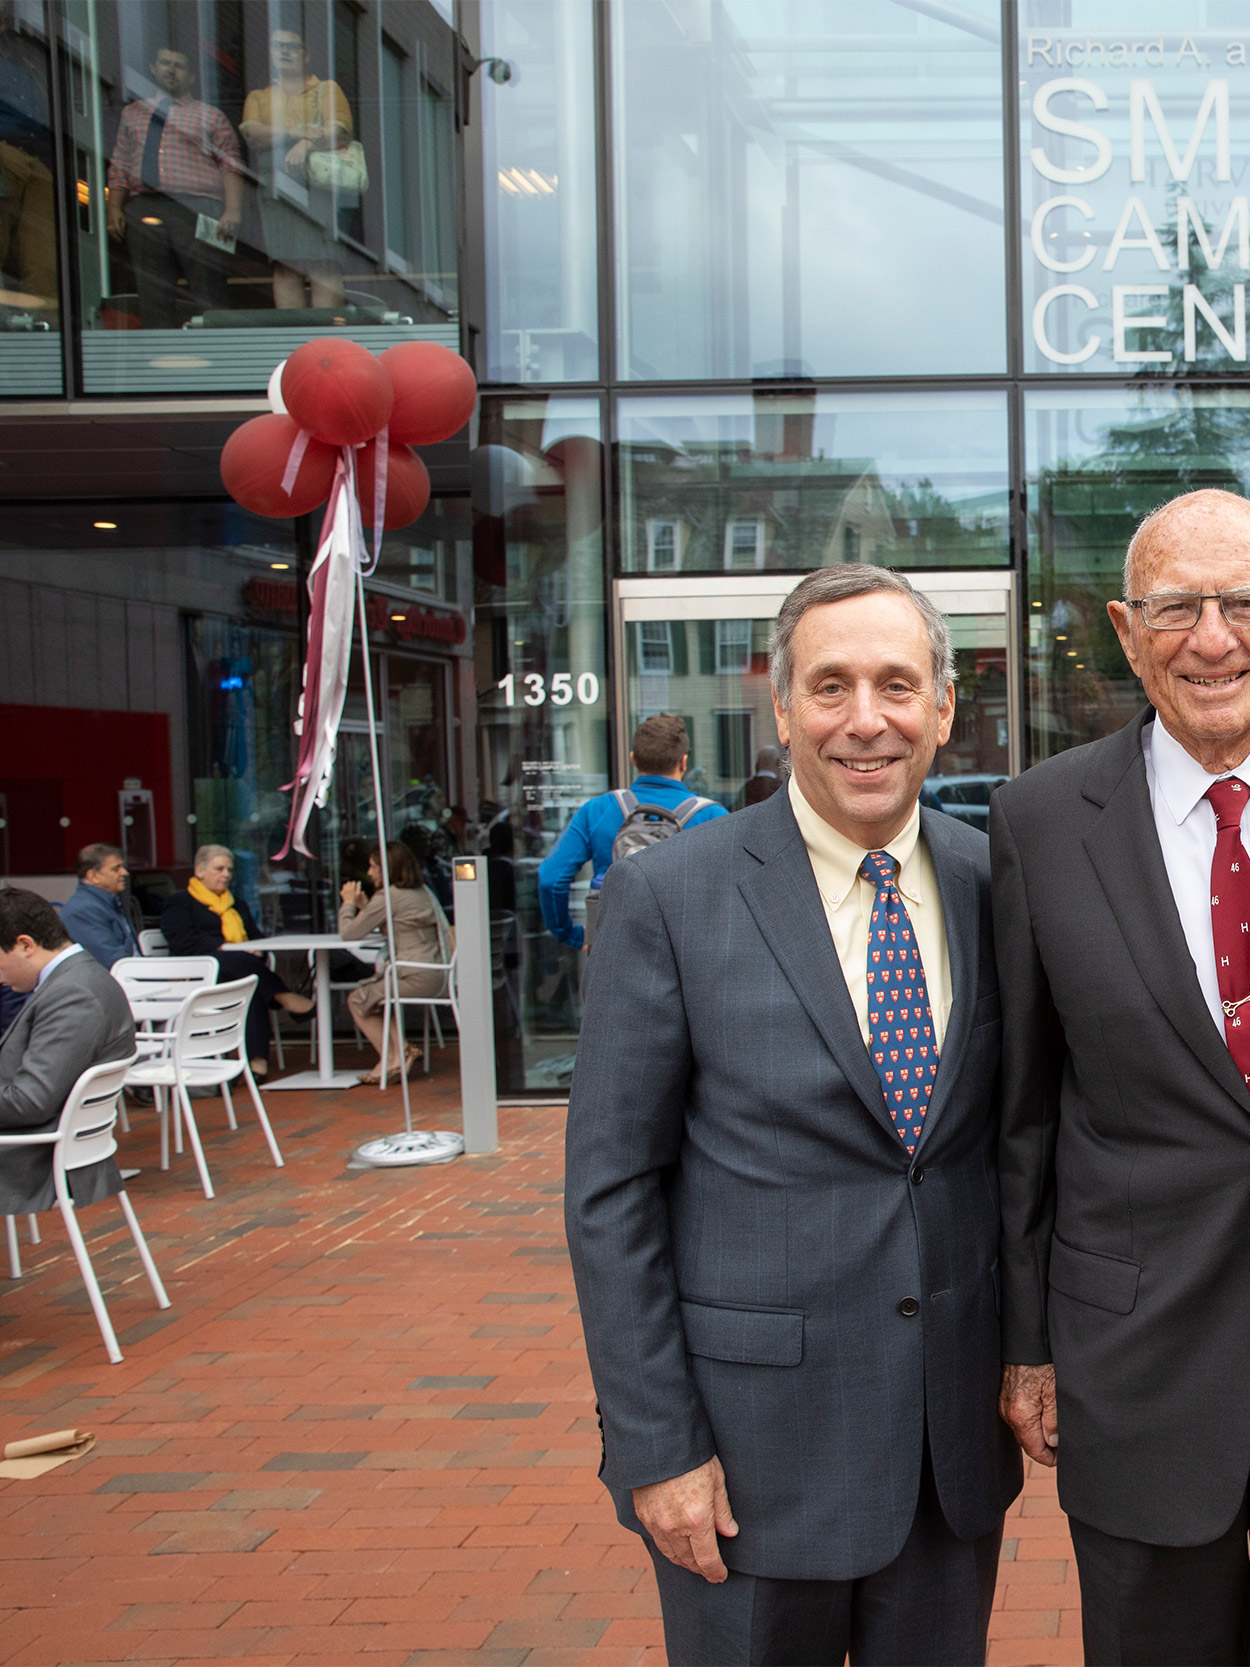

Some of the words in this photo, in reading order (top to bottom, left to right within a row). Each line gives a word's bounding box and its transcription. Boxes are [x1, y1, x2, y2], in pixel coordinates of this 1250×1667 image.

[1026, 34, 1163, 66] Richard
[1176, 35, 1211, 66] A.
[497, 672, 600, 707] 1350
[1230, 862, 1240, 873] 46
[1240, 922, 1249, 933] H
[1221, 955, 1230, 967] H
[1232, 1016, 1242, 1028] 46
